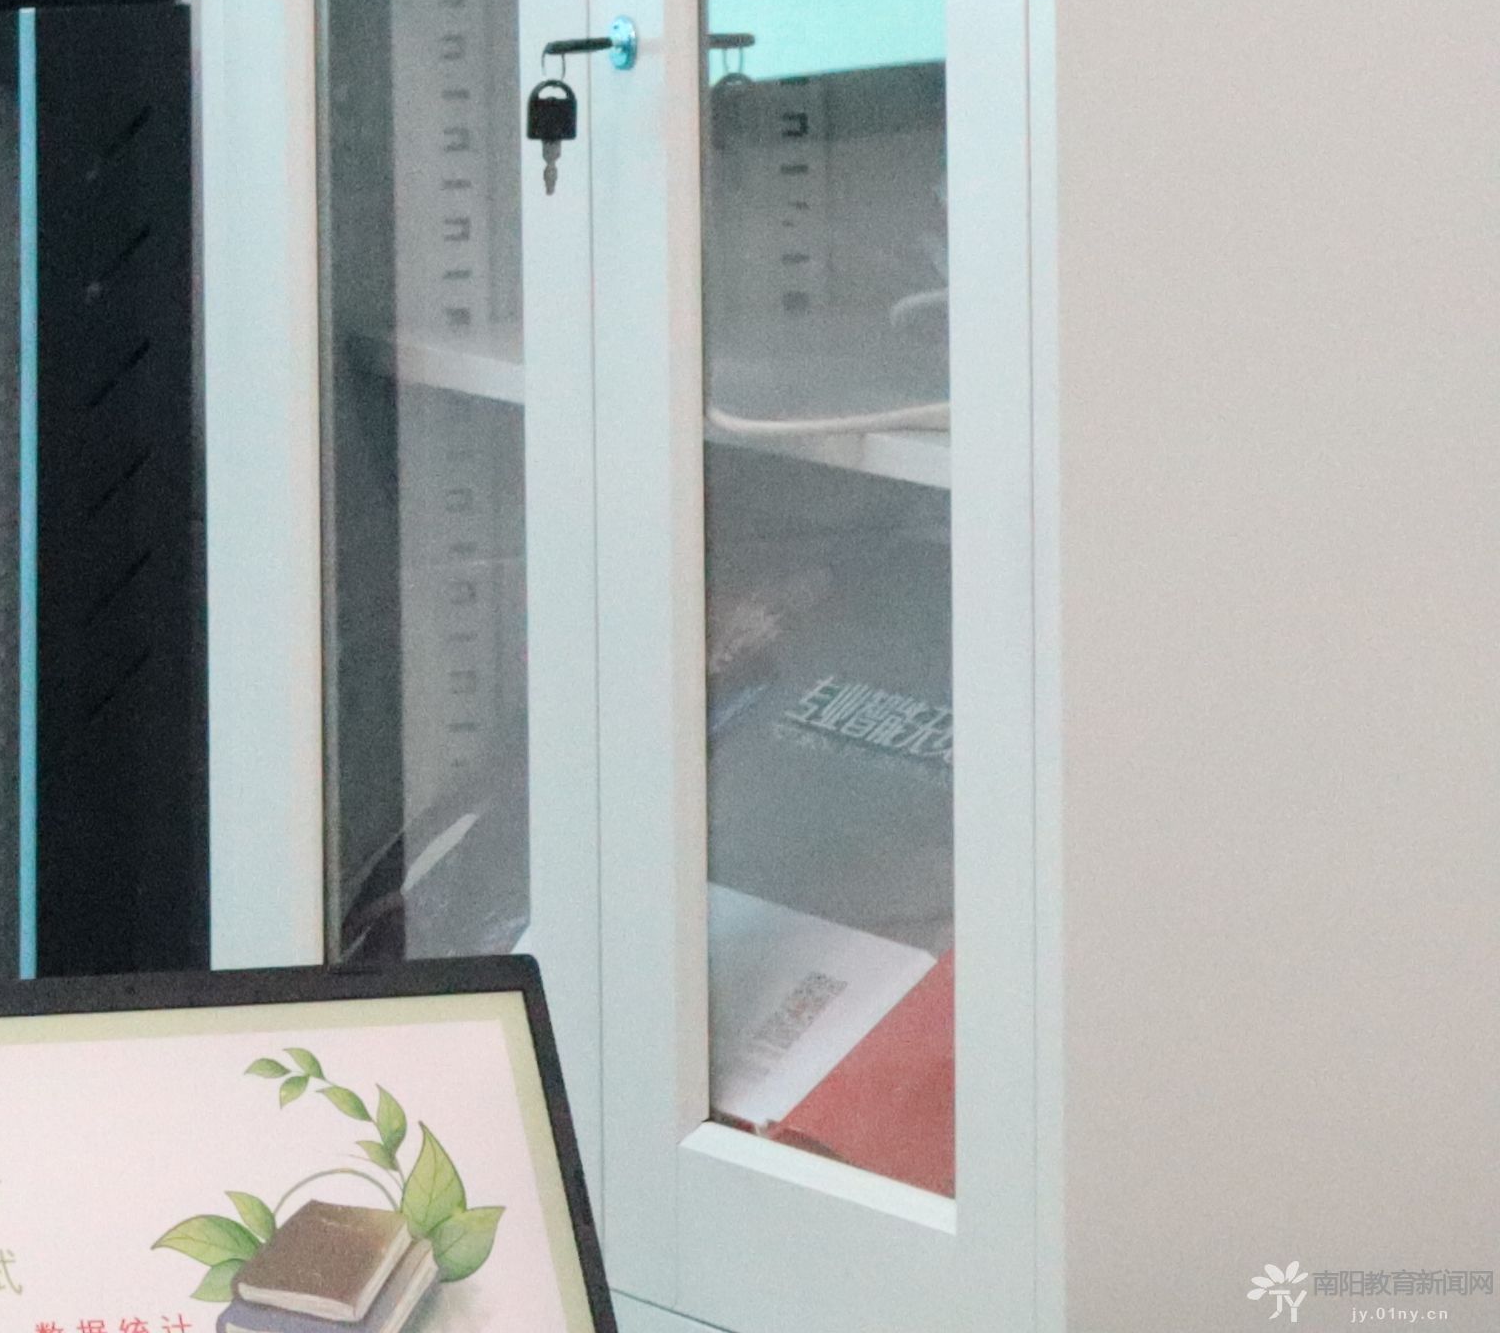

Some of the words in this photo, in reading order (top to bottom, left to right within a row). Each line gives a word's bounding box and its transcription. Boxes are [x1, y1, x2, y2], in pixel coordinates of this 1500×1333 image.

[784, 675, 953, 763] 专业智能无
